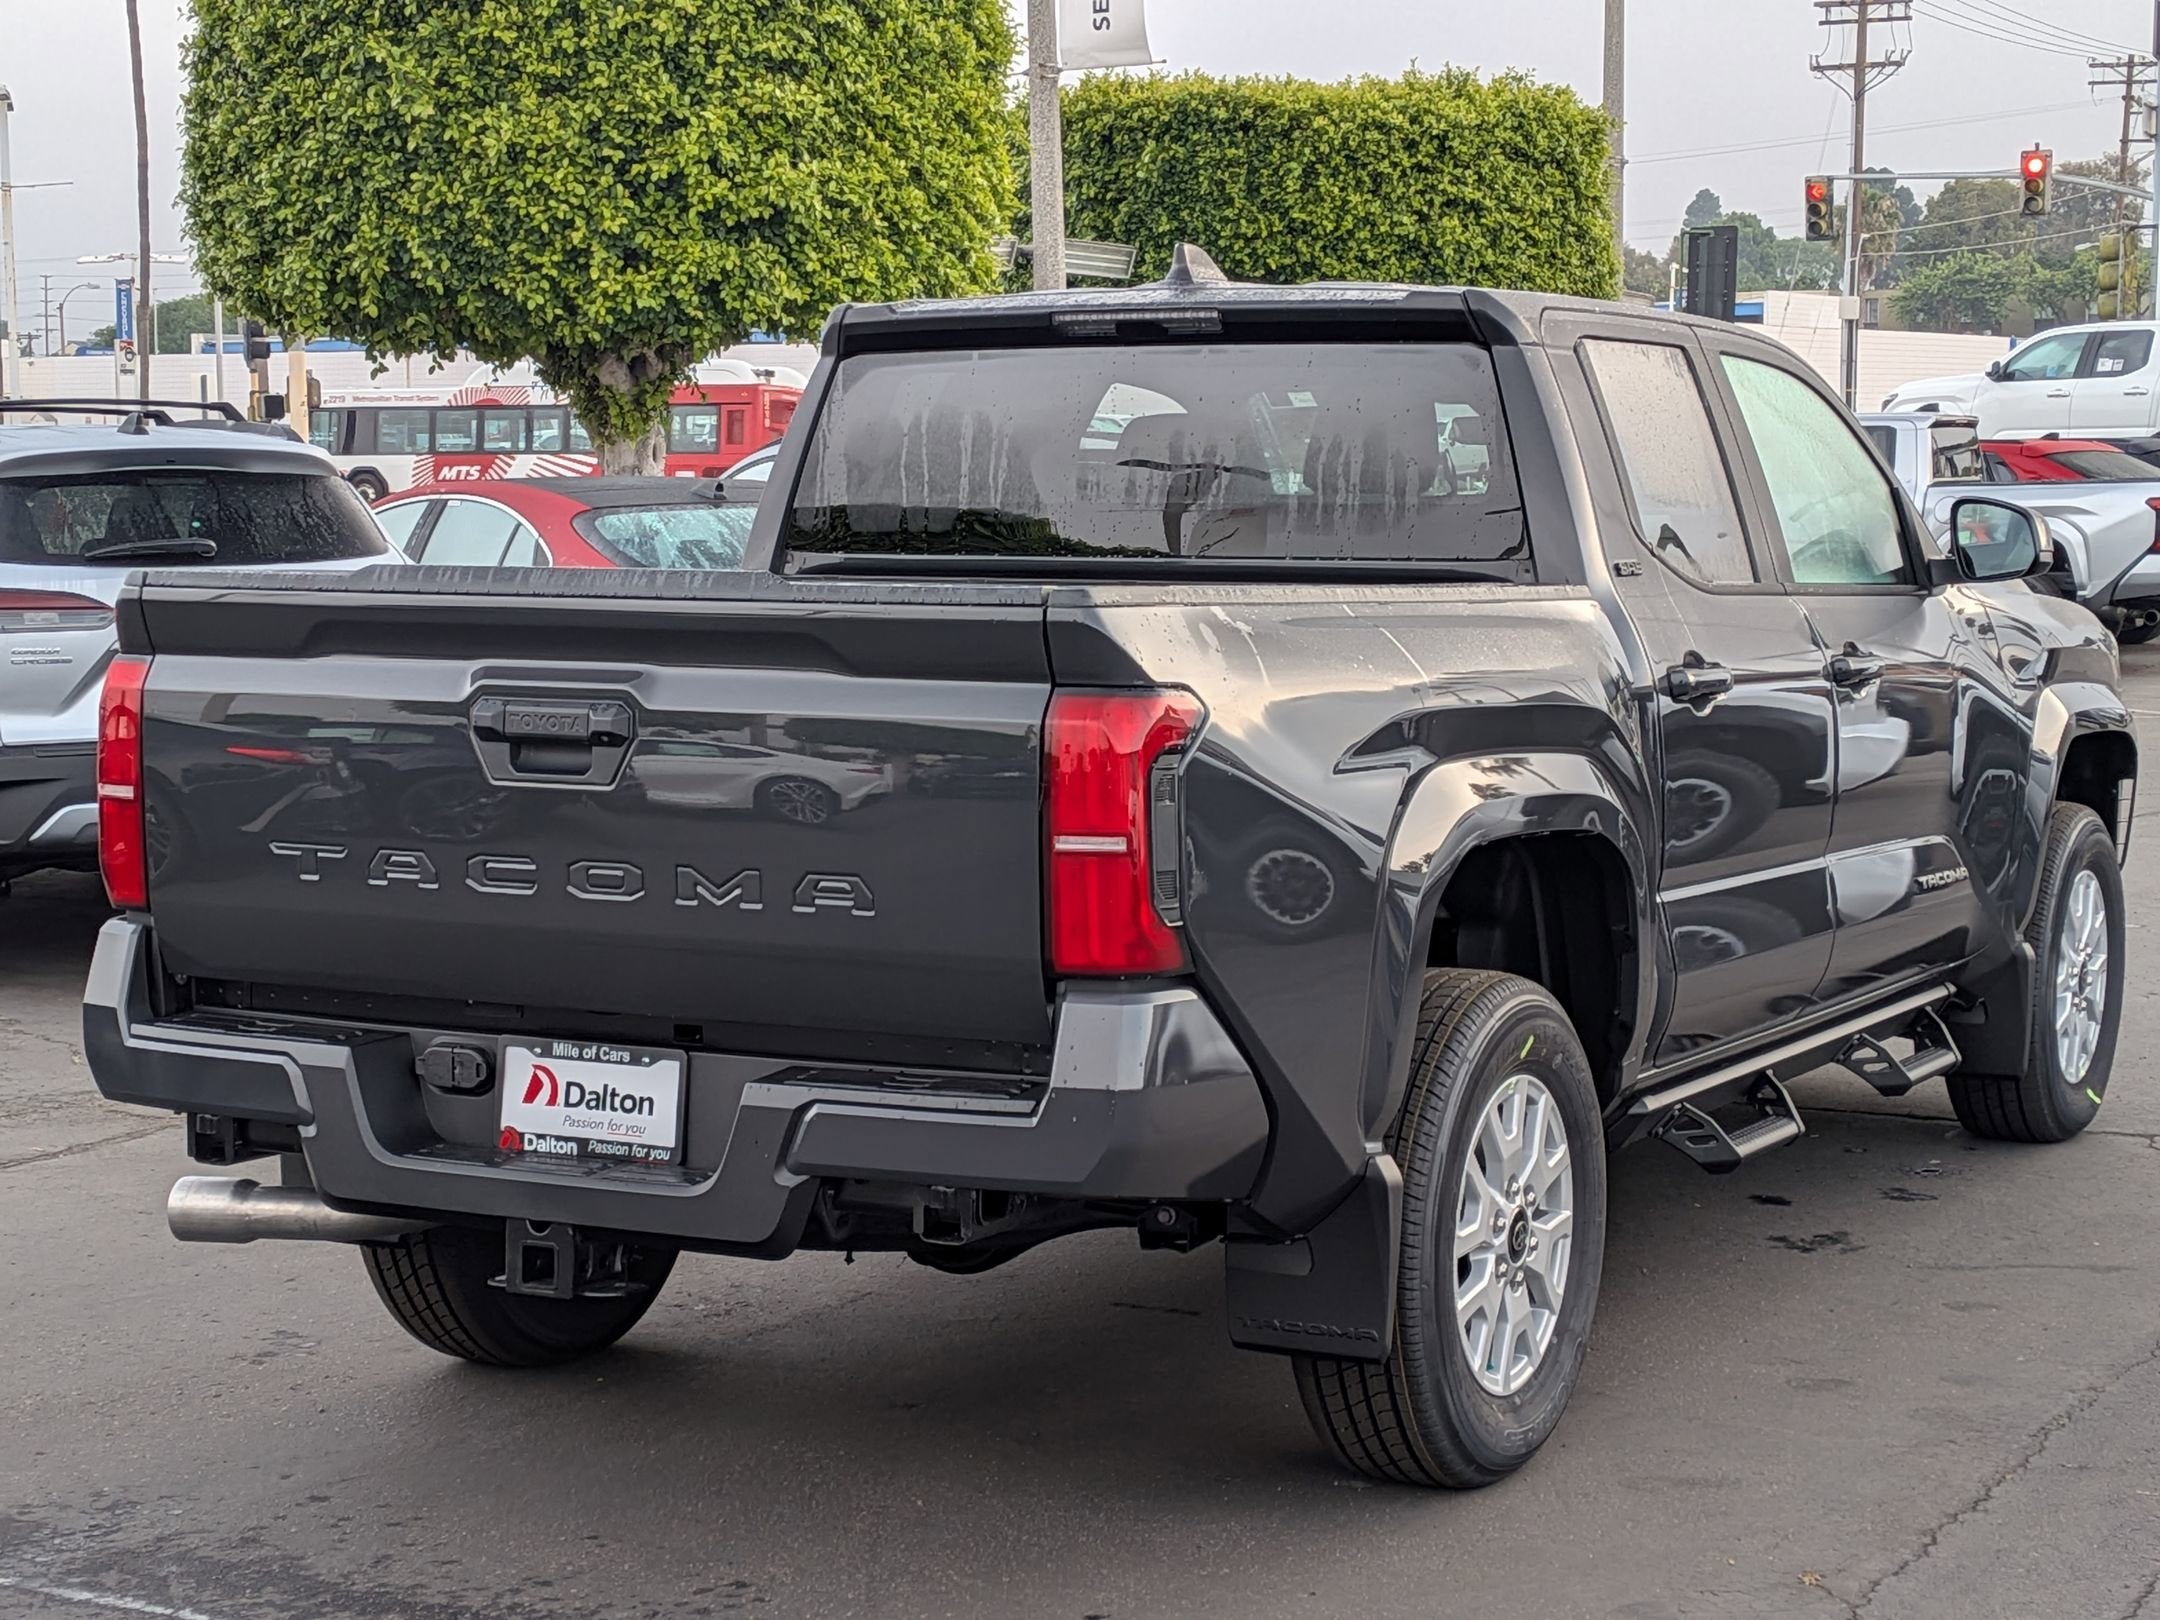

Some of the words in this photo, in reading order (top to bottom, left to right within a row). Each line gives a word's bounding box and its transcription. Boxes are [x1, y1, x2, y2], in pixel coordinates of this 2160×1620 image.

[437, 465, 481, 480] MTS
[10, 656, 73, 665] CROSS
[509, 713, 584, 733] TOYOTA
[267, 841, 877, 917] TACOMA
[1917, 867, 1969, 889] TACOMA
[552, 1042, 579, 1058] Mile
[582, 1046, 599, 1060] of
[599, 1046, 631, 1062] Cars
[563, 1081, 655, 1116] Dalton
[562, 1115, 604, 1130] Passion
[605, 1118, 624, 1132] for
[625, 1124, 647, 1136] you
[523, 1134, 578, 1156] Dalton
[587, 1140, 629, 1156] Passion
[630, 1144, 648, 1158] for
[648, 1147, 671, 1161] you
[1235, 1317, 1381, 1342] TACOMA
